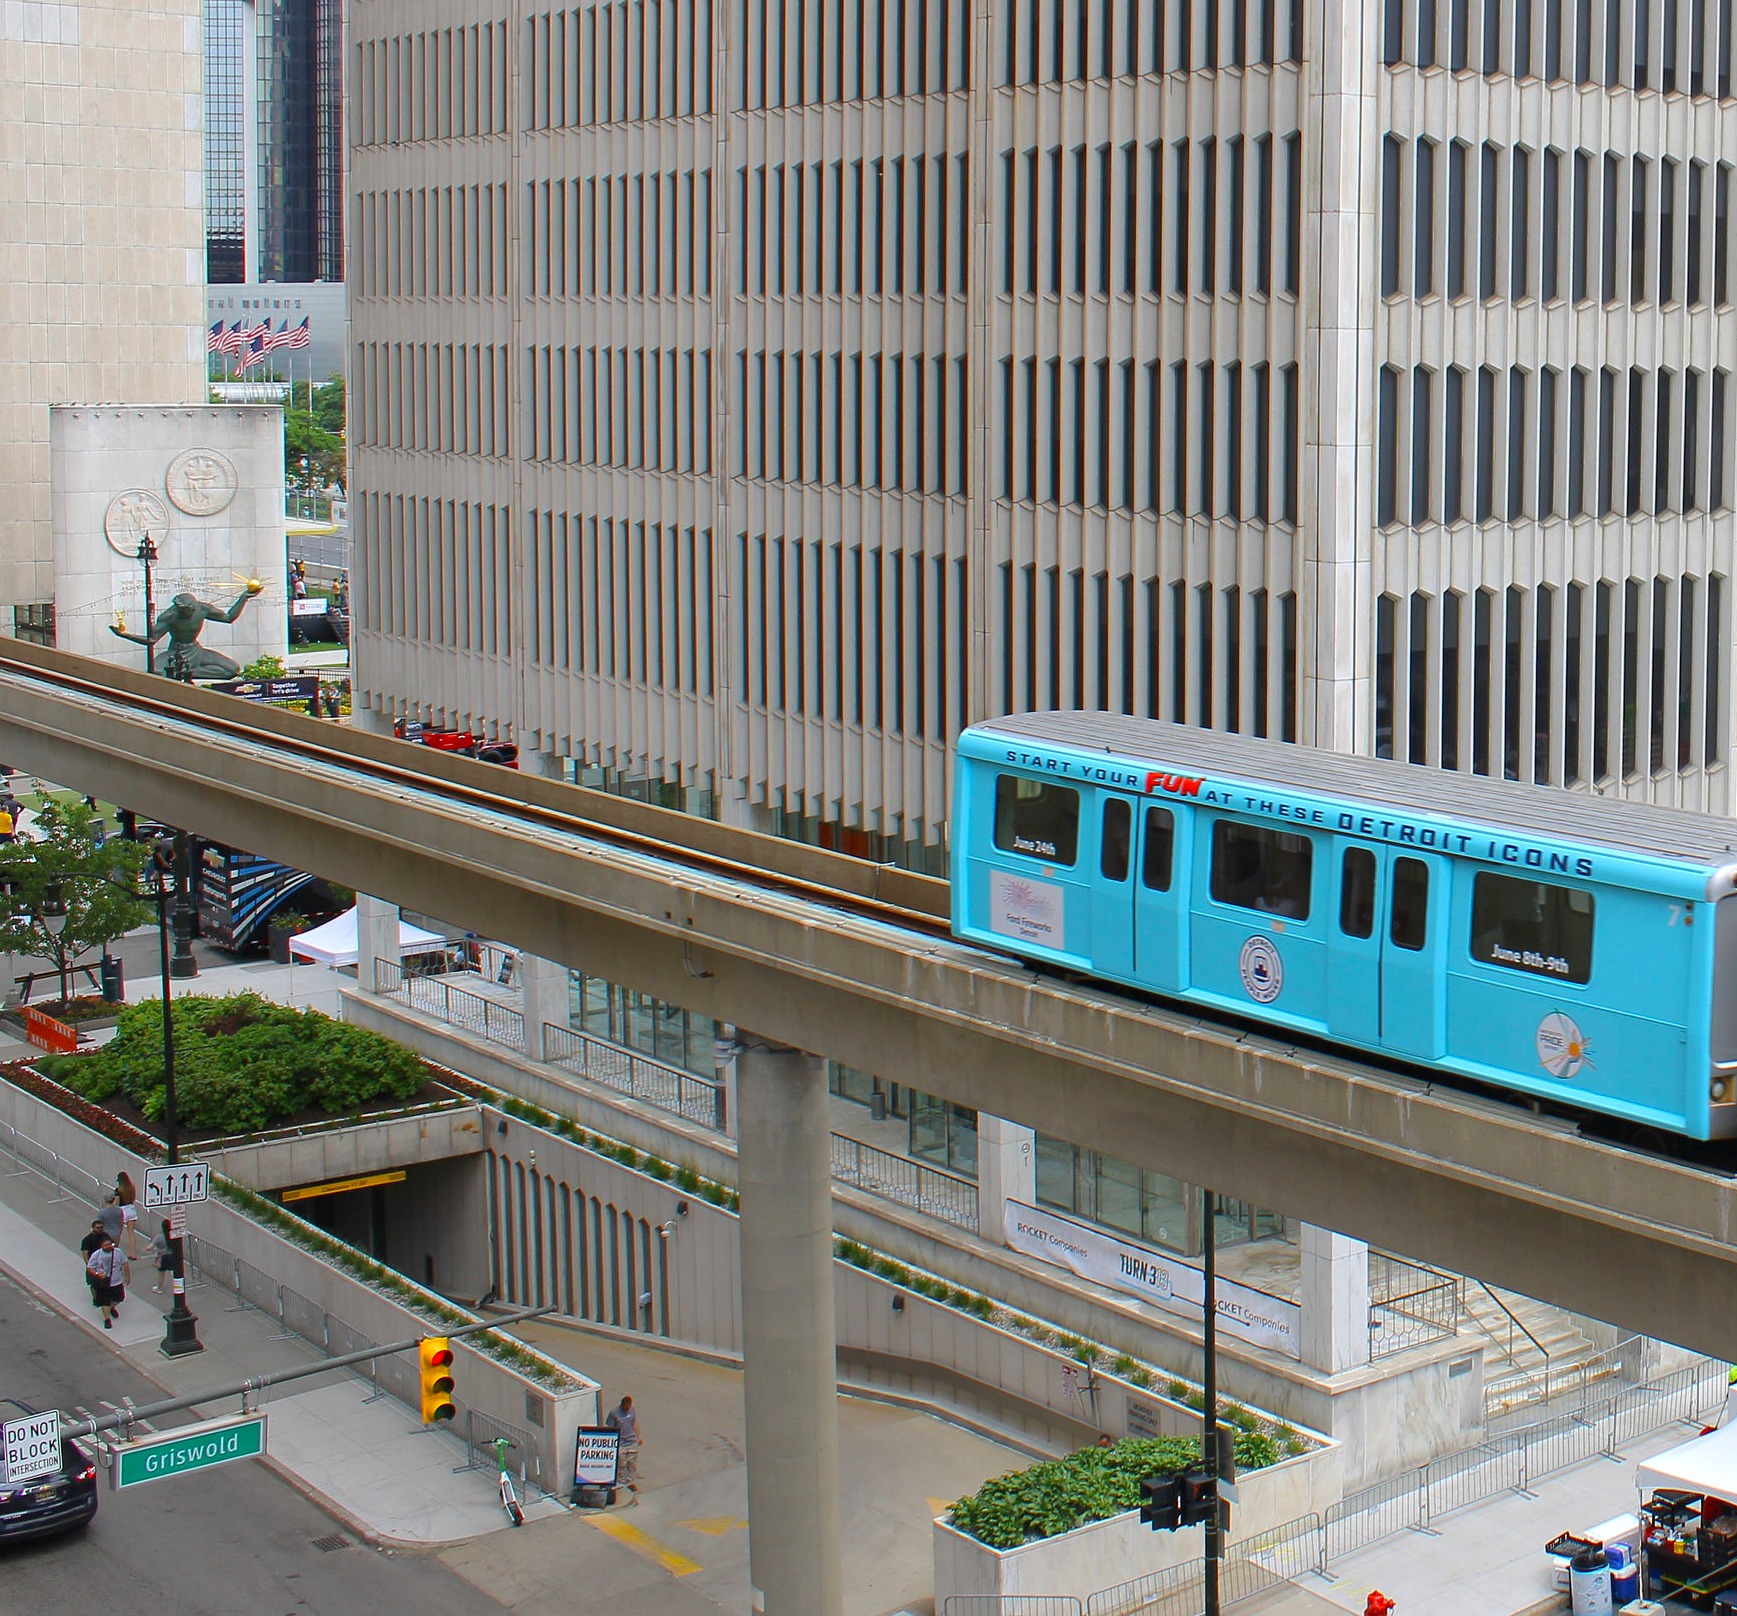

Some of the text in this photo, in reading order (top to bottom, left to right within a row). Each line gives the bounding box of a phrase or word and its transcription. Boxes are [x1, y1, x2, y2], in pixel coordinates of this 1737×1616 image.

[1006, 751, 1592, 877] START YOUR FUN AT THESE DETROIT ICONS
[1013, 835, 1035, 851] June
[1667, 904, 1681, 927] 7
[1491, 943, 1570, 974] June 8th-9th
[1540, 1033, 1564, 1047] PRIDE
[1049, 1234, 1089, 1258] Companies
[1119, 1253, 1170, 1291] TURN 313
[1244, 1309, 1290, 1335] Companies
[8, 1420, 56, 1444] DO NOT
[9, 1439, 58, 1464] BLOCK
[146, 1433, 238, 1472] Griswold
[580, 1450, 614, 1460] PARKING
[10, 1456, 59, 1477] INTERSECTION
